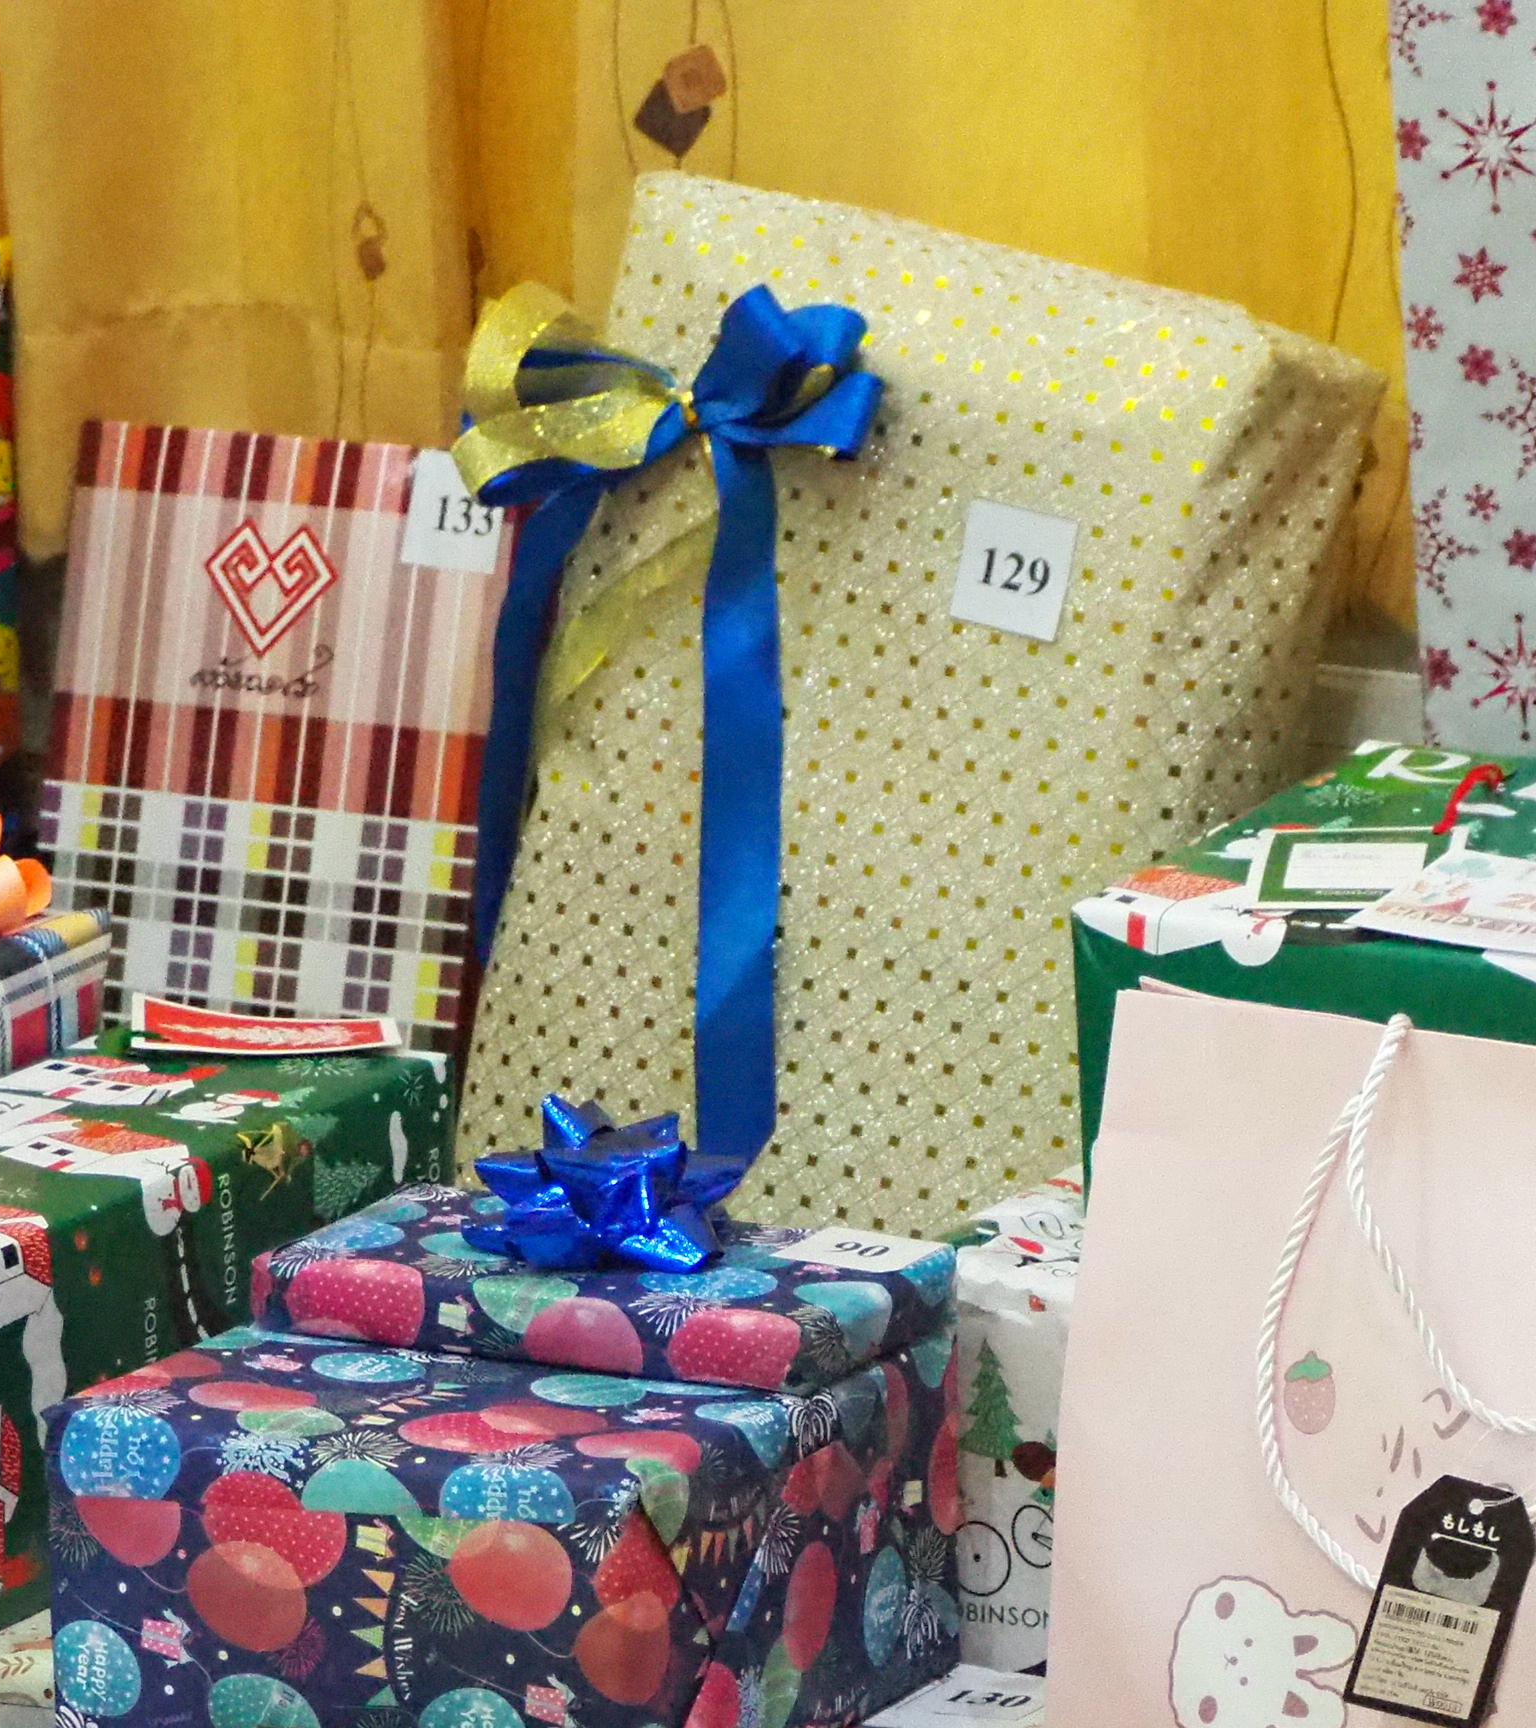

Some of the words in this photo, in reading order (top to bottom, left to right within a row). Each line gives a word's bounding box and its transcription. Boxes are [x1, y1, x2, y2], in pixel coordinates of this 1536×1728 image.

[432, 493, 495, 537] 133
[981, 546, 1051, 597] 129
[216, 1172, 237, 1306] ROBINSON
[834, 1240, 890, 1260] 90
[1441, 1512, 1501, 1543] もしもし
[91, 1640, 109, 1703] Happy
[948, 1689, 1032, 1708] 130
